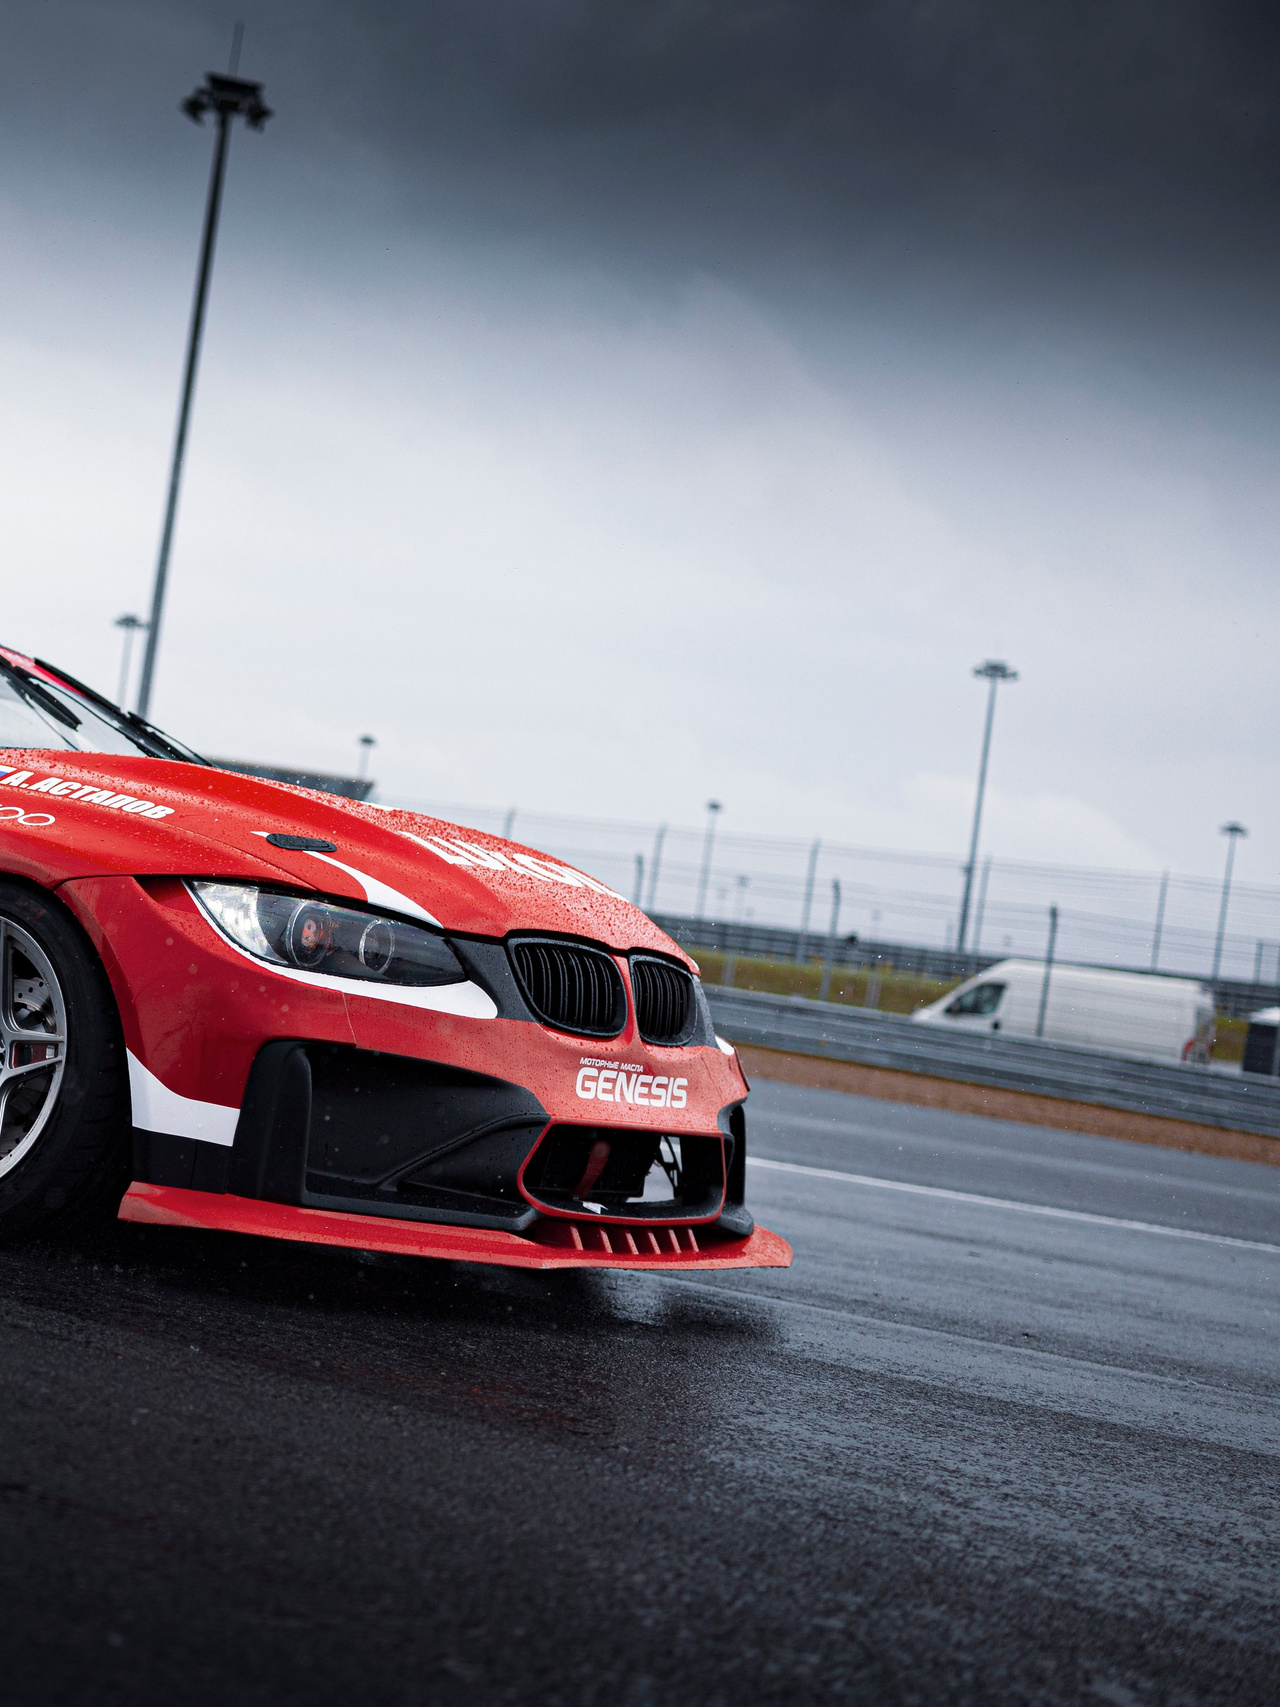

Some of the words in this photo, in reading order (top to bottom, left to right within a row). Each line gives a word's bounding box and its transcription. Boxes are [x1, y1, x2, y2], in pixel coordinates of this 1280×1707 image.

[0, 770, 175, 819] А.АСТАПОВ
[580, 1057, 619, 1069] МОТОРНЫЕ
[576, 1067, 688, 1109] GENESIS
